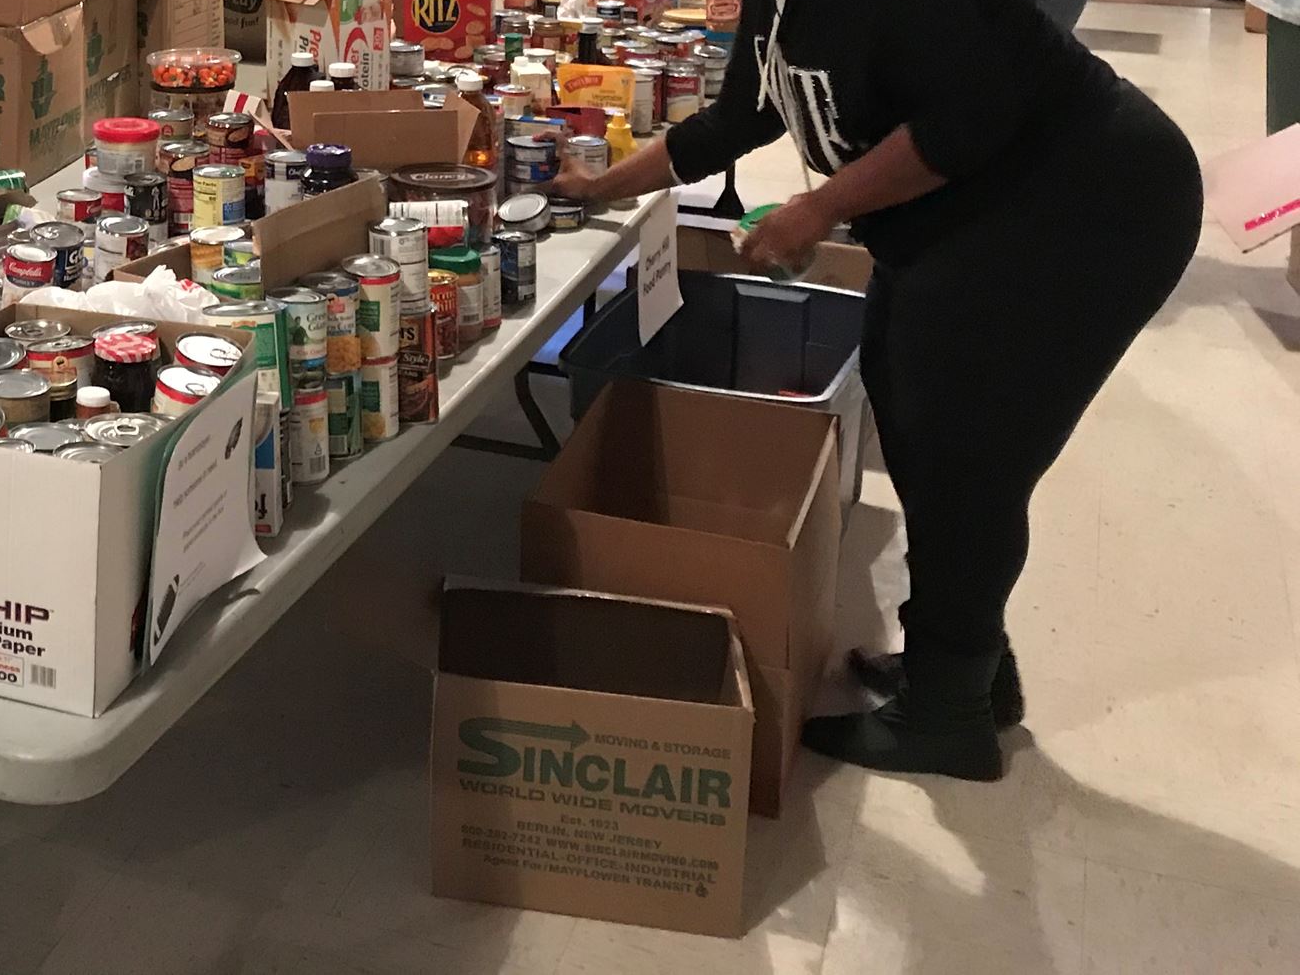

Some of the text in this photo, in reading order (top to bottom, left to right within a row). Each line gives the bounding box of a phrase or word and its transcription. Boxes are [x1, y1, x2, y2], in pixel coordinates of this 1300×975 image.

[361, 52, 370, 92] otein
[457, 716, 733, 809] SINCLAIR
[594, 733, 732, 760] MOVING & STORAGE
[458, 778, 726, 826] WORLD WIDE MOVERS
[560, 814, 586, 827] Est.
[574, 829, 605, 841] NEW
[608, 833, 662, 850] JERSEY
